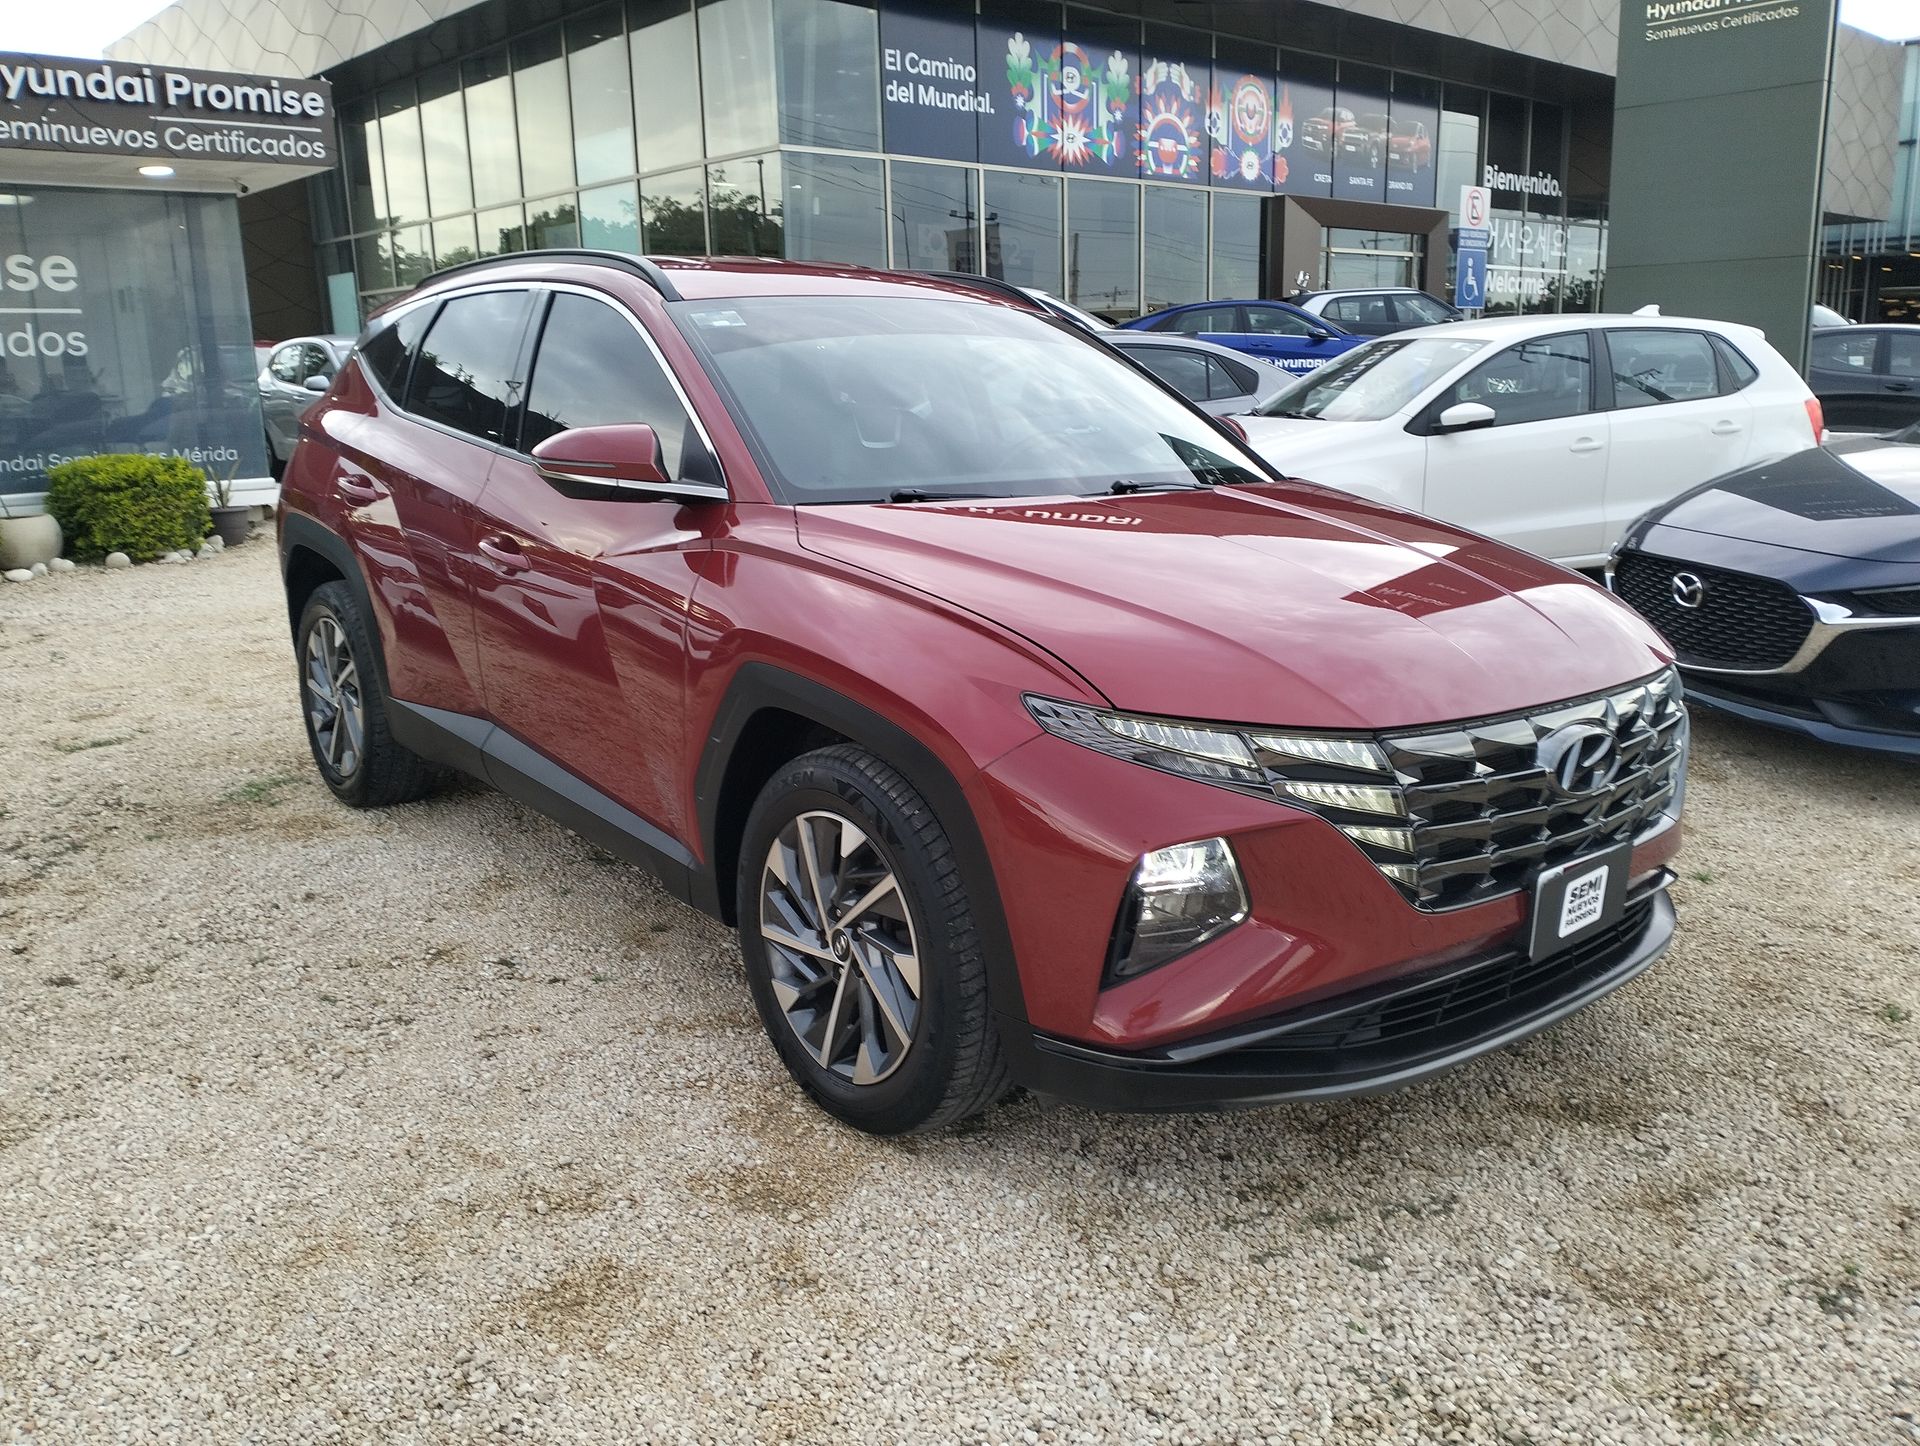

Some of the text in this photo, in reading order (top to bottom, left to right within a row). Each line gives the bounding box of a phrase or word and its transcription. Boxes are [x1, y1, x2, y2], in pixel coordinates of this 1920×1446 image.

[1645, 5, 1800, 41] Seminuevos Certificados
[884, 48, 976, 83] El Camino
[164, 73, 325, 116] Promise
[886, 80, 995, 114] del Mundial.
[164, 126, 327, 159] Certificados
[1483, 164, 1563, 197] Bienvenido.
[0, 254, 79, 292] se
[0, 322, 89, 357] dos
[1569, 874, 1603, 904] SEMI
